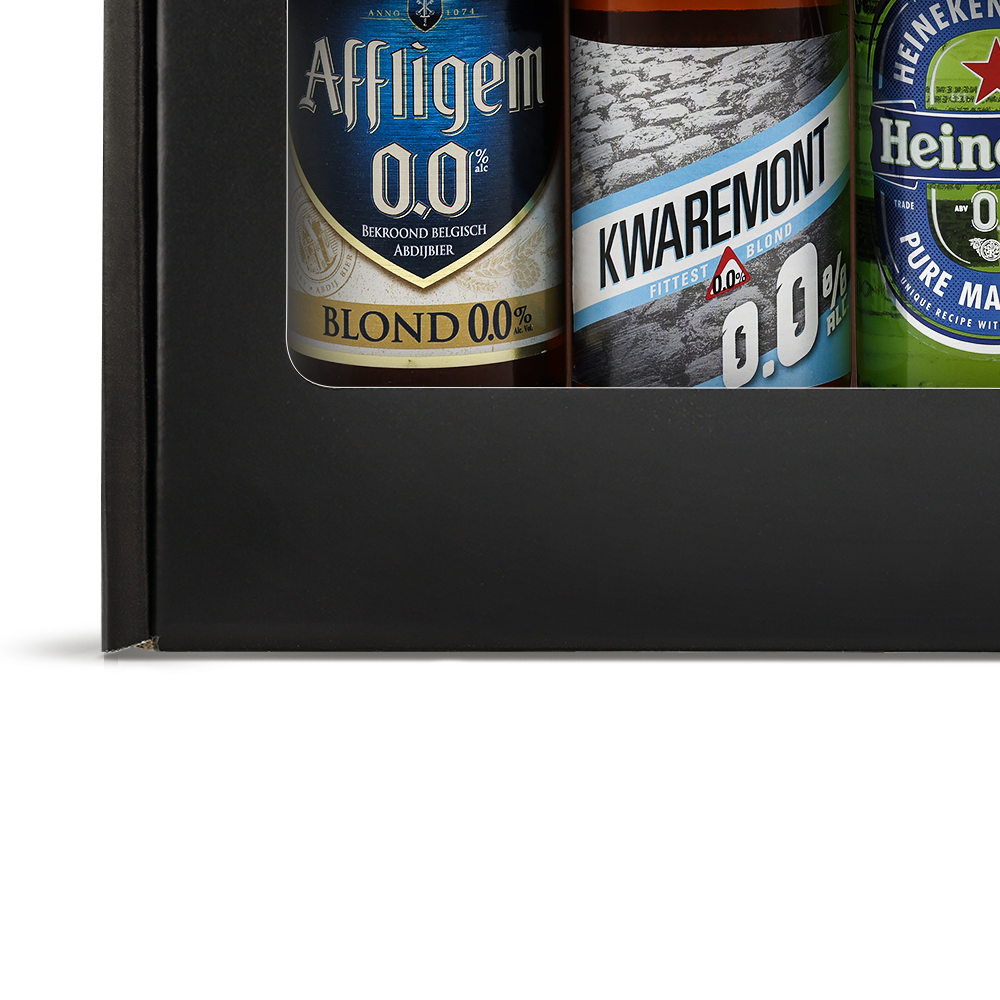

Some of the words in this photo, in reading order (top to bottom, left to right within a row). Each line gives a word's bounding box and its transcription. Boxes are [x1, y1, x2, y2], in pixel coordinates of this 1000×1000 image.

[446, 8, 475, 16] 1074
[299, 36, 545, 135] Affligem
[475, 164, 489, 172] alc
[599, 117, 830, 290] KWAREMONT
[894, 200, 914, 210] TRADE
[362, 225, 428, 238] BEKROOND
[432, 224, 487, 238] BELGISCH
[393, 244, 455, 258] ABDIJBIER
[650, 264, 709, 299] FITTEST
[746, 223, 793, 259] BLOND
[900, 232, 952, 297] PURE
[712, 269, 747, 295] 0.0%
[901, 277, 931, 310] UNIQUE
[936, 308, 972, 327] RECIPE
[322, 305, 460, 344] BLOND
